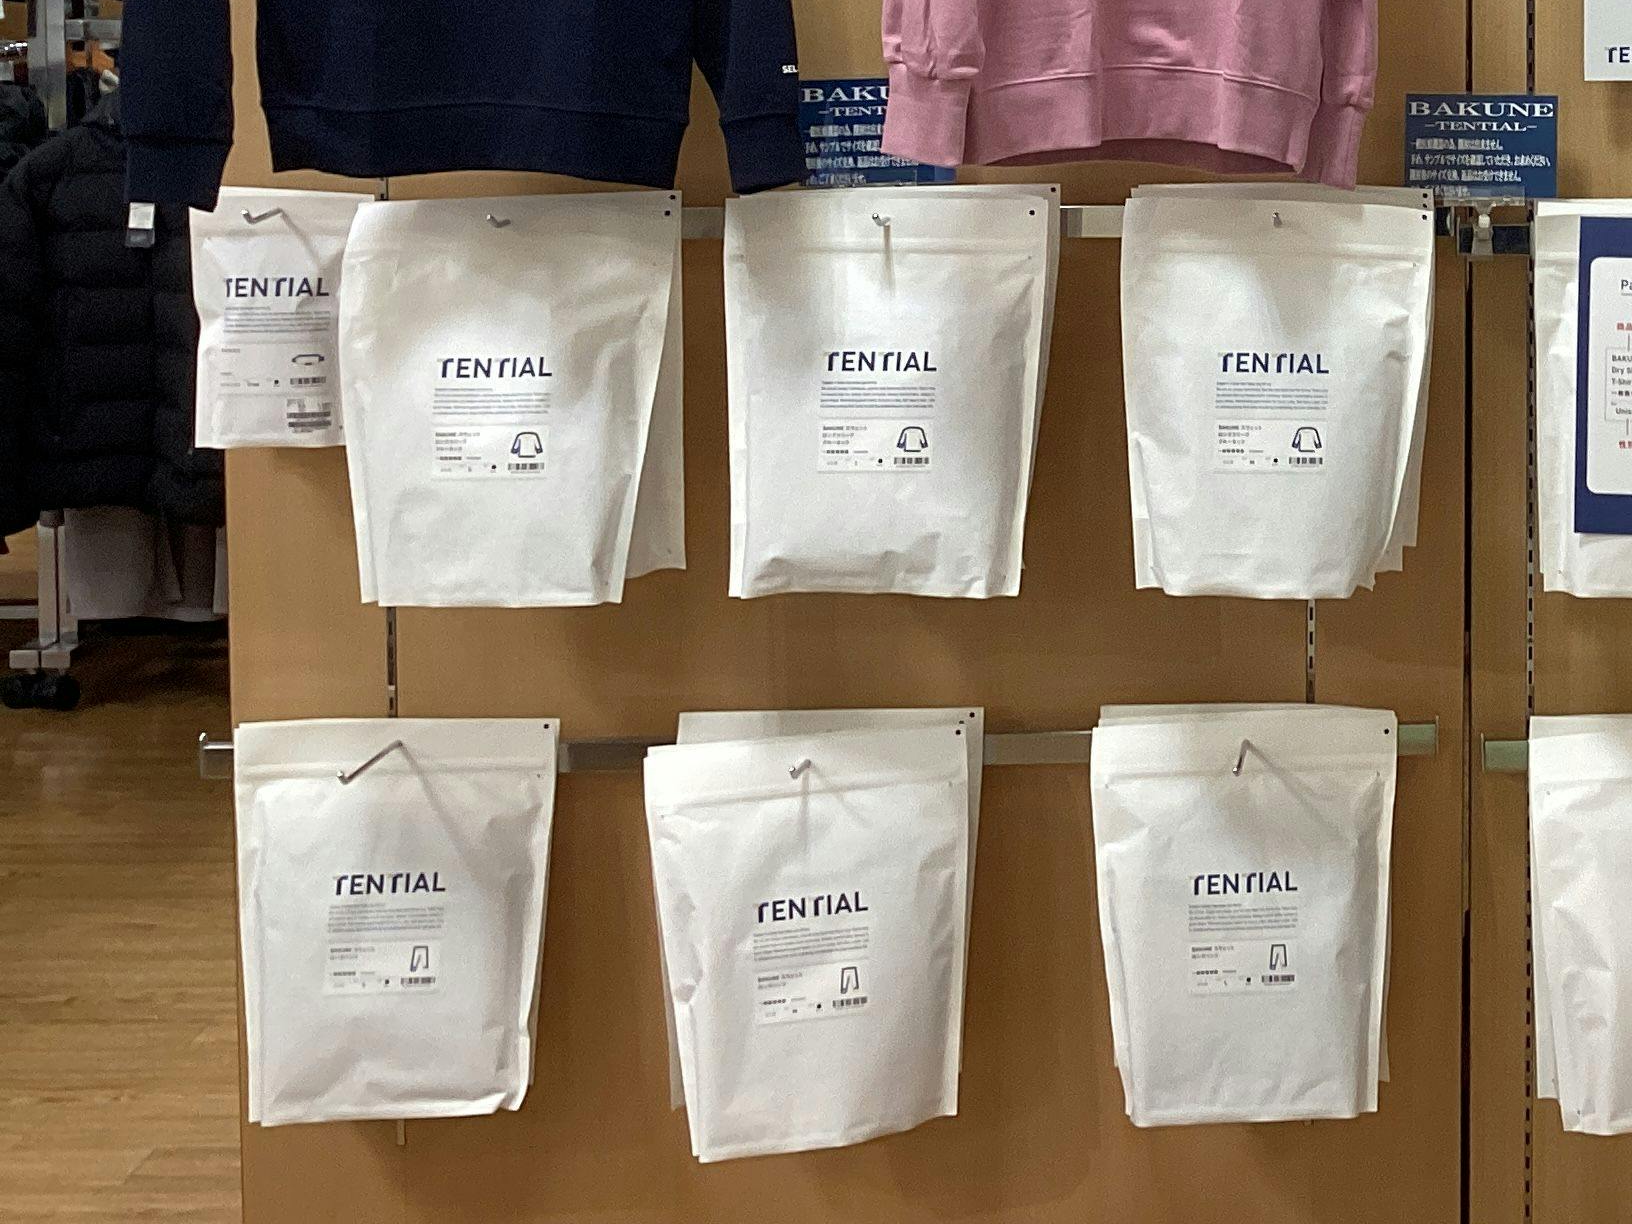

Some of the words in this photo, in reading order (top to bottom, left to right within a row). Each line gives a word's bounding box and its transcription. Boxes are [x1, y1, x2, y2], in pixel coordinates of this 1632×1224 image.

[1408, 101, 1554, 118] BAKUNE
[225, 277, 330, 298] TENTIAL
[437, 356, 553, 379] TENTIAL
[825, 351, 937, 372] TENTIAL
[1218, 352, 1330, 374] TENTIAL
[334, 871, 446, 896] TENTIAL
[1190, 870, 1298, 896] TENTIAL
[754, 890, 869, 924] TENTIAL
